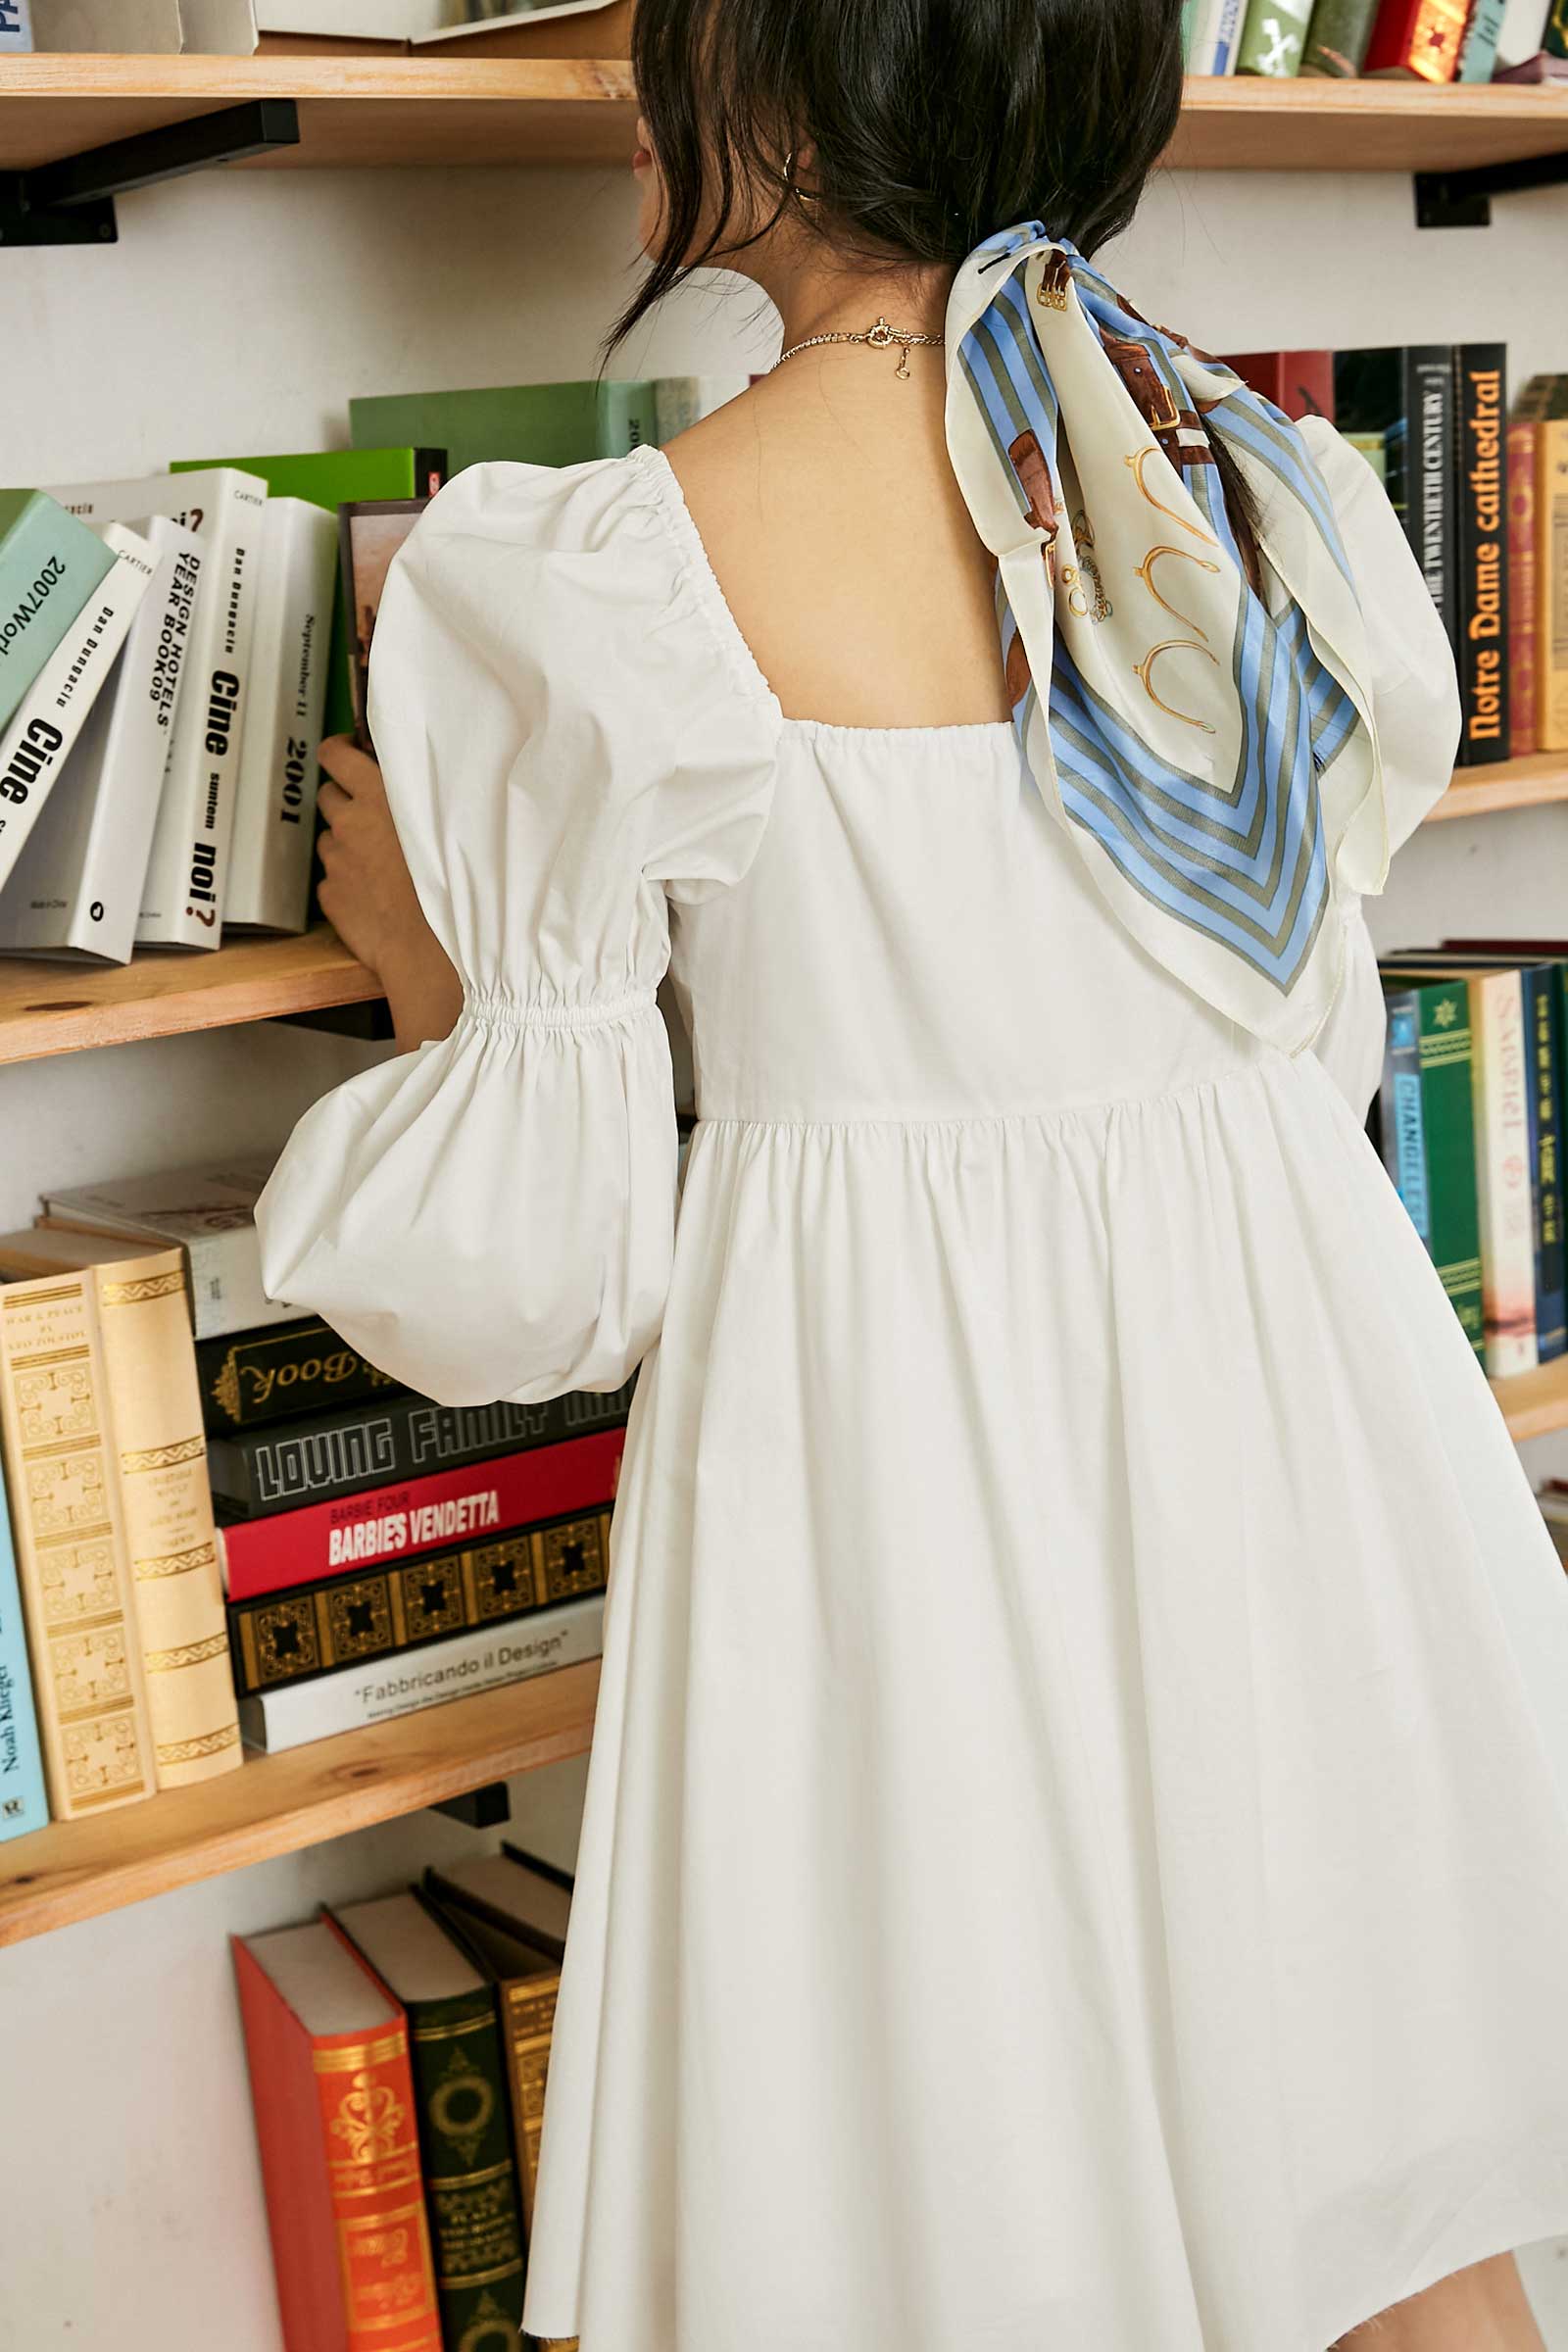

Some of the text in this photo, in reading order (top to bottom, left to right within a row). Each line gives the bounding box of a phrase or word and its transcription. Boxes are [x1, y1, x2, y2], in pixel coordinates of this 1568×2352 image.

[234, 489, 265, 508] CARTIER
[118, 549, 154, 576] CARTIER
[167, 550, 192, 608] YEAR
[234, 547, 245, 575] Dan
[1469, 369, 1500, 741] Notre Dame cathedral
[93, 606, 115, 635] Dan
[174, 555, 202, 637] DESIGN
[204, 669, 240, 757] Cine
[0, 717, 64, 806] Cine
[280, 736, 308, 825] 2001
[205, 772, 220, 830] suntem
[240, 1351, 357, 1404] Book
[256, 1417, 396, 1501] LOVING
[330, 1491, 410, 1525] BARBIE FOUR
[409, 1490, 501, 1545] VENDETTA
[483, 1653, 494, 1672] il
[0, 1726, 20, 1774] Noah
